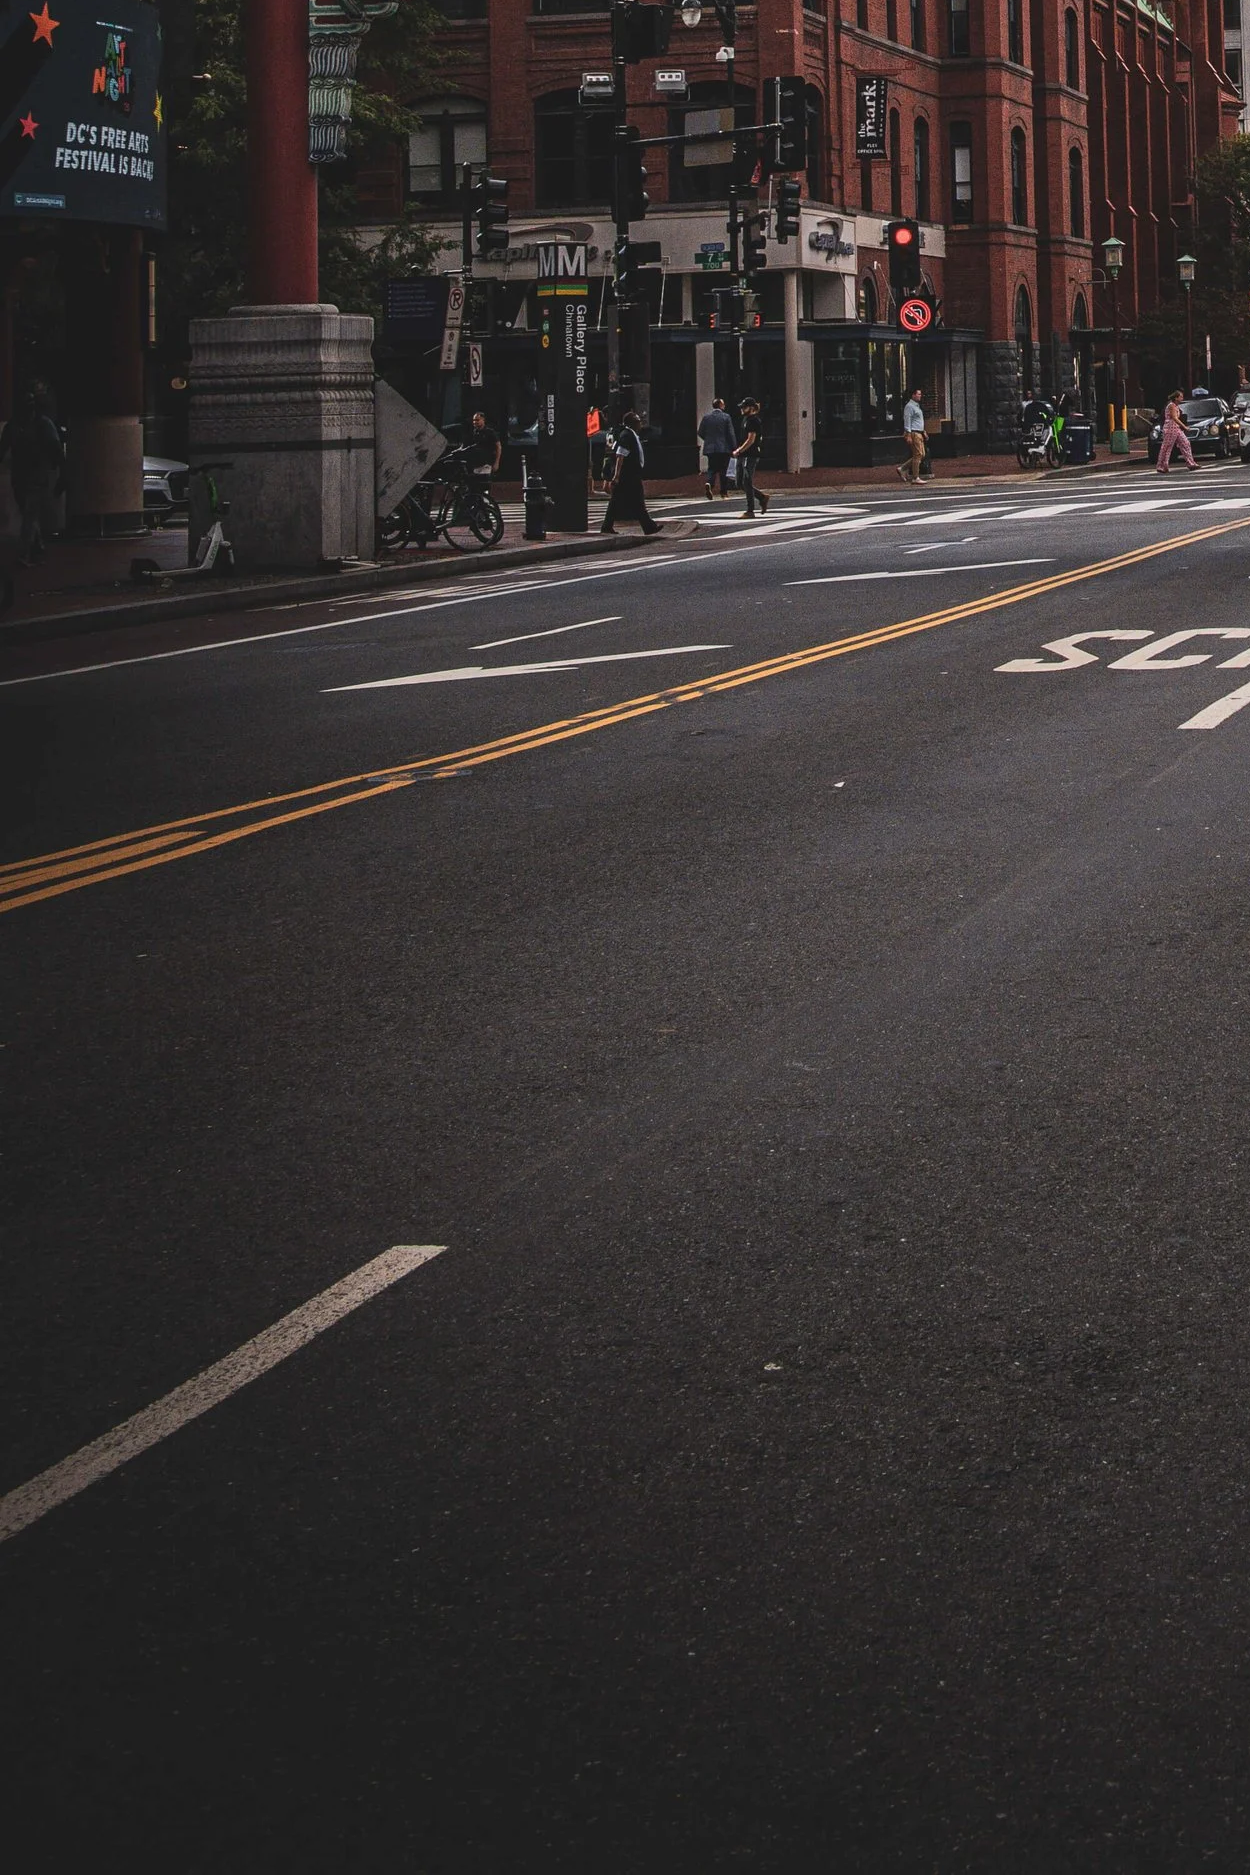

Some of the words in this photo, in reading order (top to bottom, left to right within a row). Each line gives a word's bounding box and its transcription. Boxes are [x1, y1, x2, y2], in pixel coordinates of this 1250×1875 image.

[66, 121, 98, 145] DC'S
[101, 126, 127, 149] FREE
[128, 131, 150, 154] ARTS
[857, 123, 866, 138] the
[55, 147, 116, 173] FESTIVAL
[118, 155, 129, 175] IS
[539, 246, 555, 277] M
[557, 245, 586, 276] M
[565, 304, 575, 358] Chinatown
[574, 305, 588, 352] Gallery
[575, 356, 588, 393] Place
